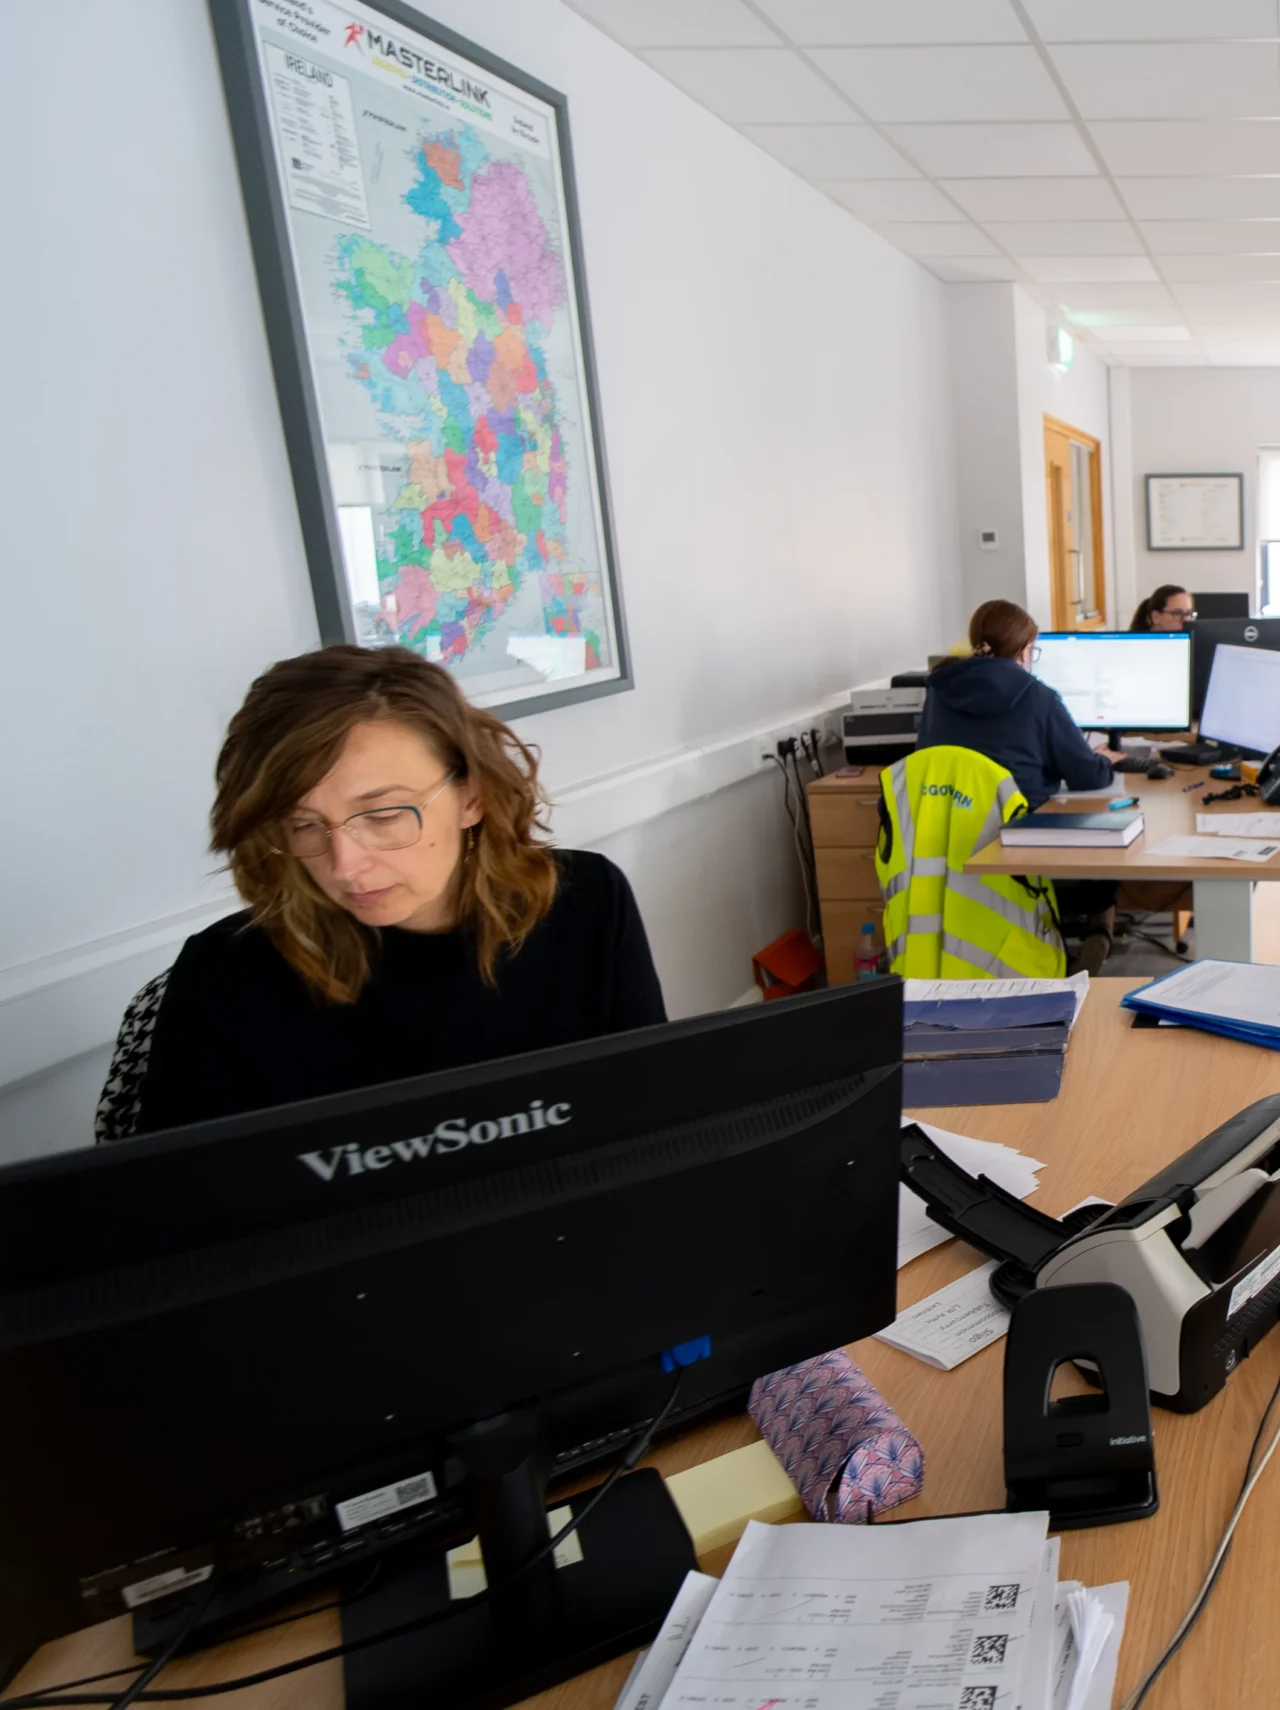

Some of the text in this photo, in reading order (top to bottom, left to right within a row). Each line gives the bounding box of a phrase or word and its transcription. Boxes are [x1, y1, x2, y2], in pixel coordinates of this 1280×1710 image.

[285, 53, 334, 88] IRELAND
[366, 28, 491, 109] MASTERLINK
[297, 1099, 573, 1181] ViewSonic
[968, 1327, 994, 1343] Sligo
[1109, 1435, 1147, 1446] initiative
